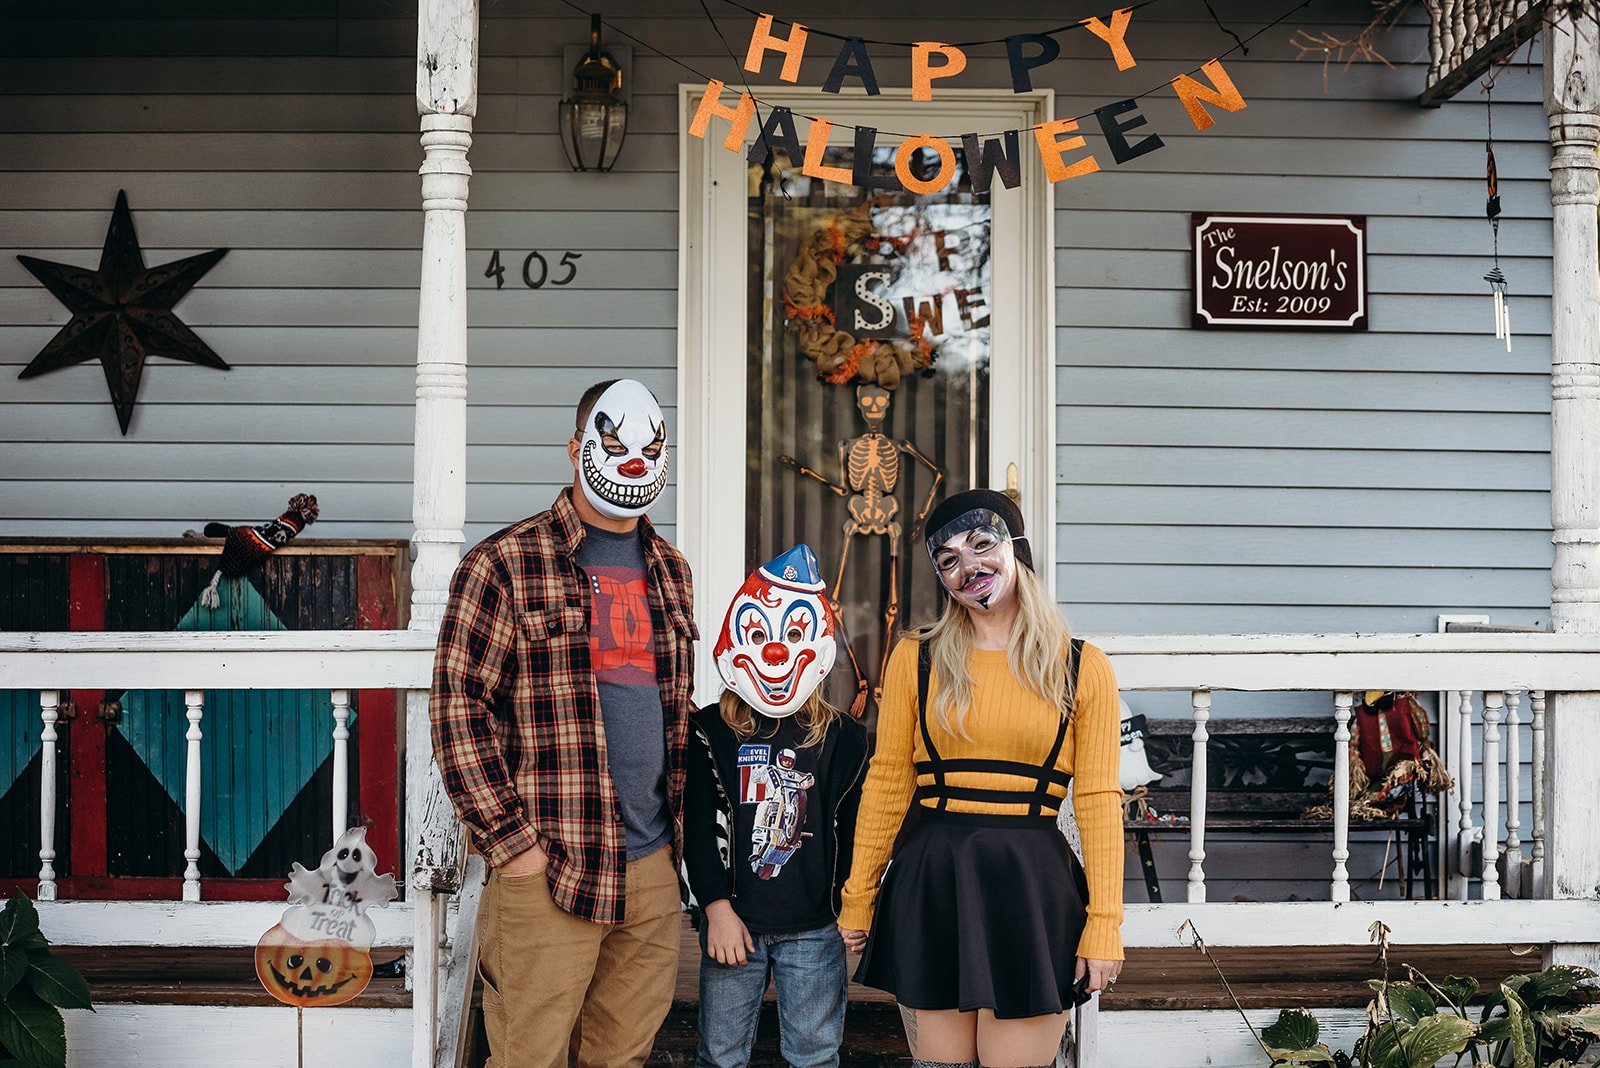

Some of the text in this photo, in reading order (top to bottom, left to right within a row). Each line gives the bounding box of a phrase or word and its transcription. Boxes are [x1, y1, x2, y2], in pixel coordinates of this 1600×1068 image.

[744, 8, 1137, 102] HAPPY
[688, 58, 1248, 195] HALLOWEEN
[1203, 227, 1236, 249] The
[484, 249, 582, 290] 405
[1212, 246, 1348, 291] Snelson's
[855, 271, 894, 331] S
[1230, 295, 1331, 314] Est: 2009
[738, 755, 767, 763] KNIEVEL
[750, 748, 768, 756] EVEL
[322, 883, 363, 917] Trick
[310, 911, 357, 942] Treat
